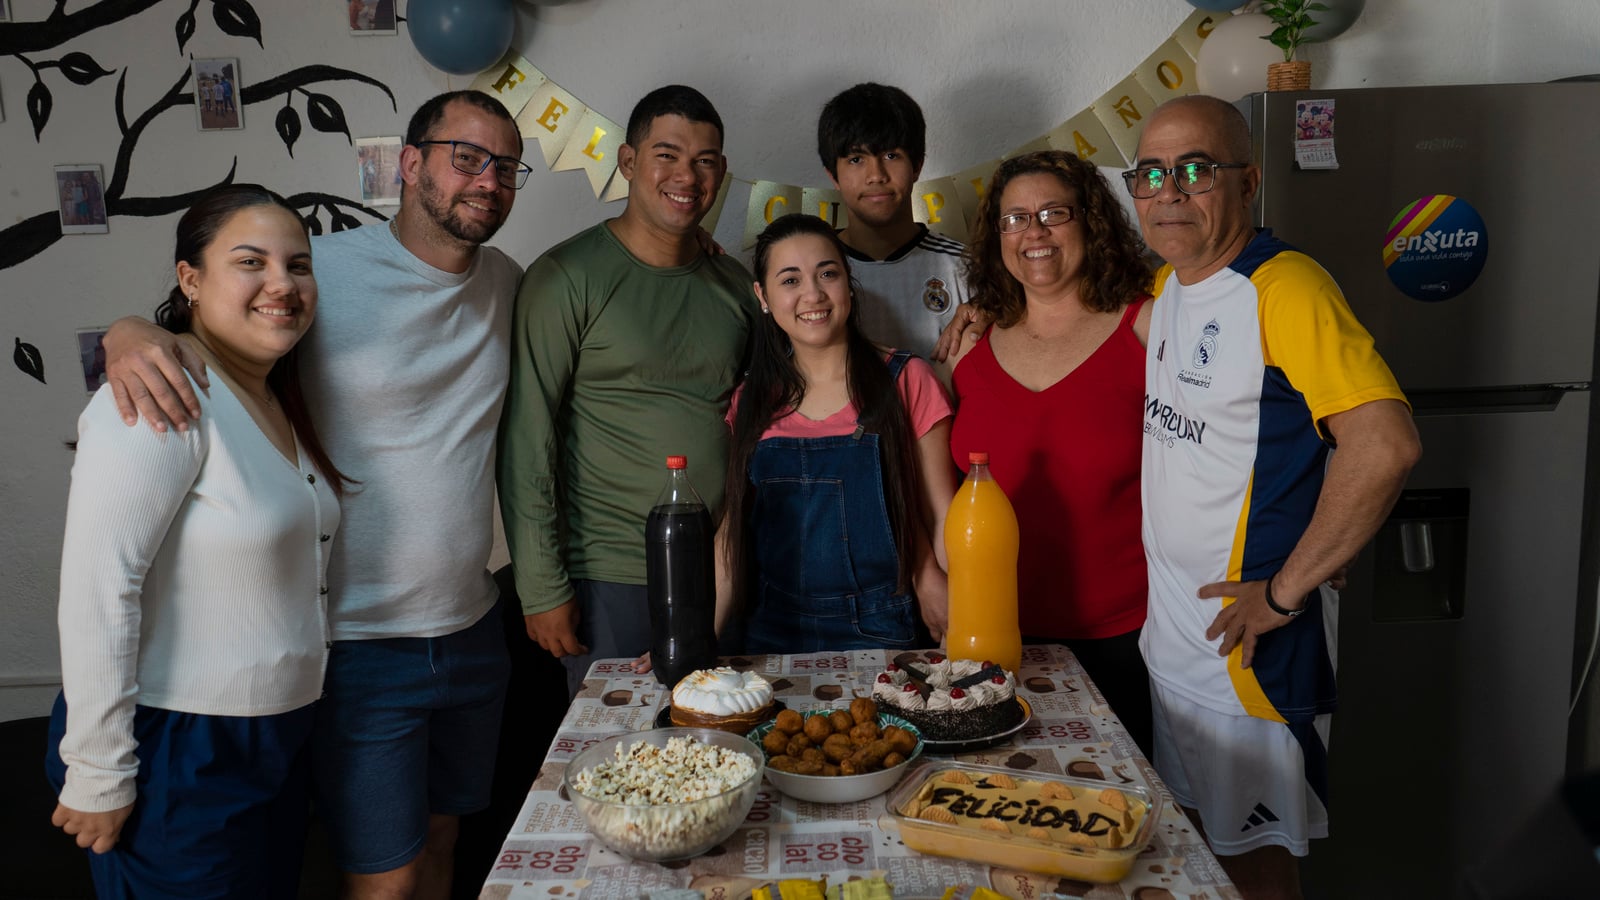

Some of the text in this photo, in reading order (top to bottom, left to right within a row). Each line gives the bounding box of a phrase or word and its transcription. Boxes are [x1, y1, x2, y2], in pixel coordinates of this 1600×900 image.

[594, 663, 618, 674] lat
[815, 658, 831, 669] co
[1048, 725, 1068, 738] co
[1066, 721, 1091, 740] cho
[554, 738, 582, 753] lat
[553, 846, 586, 873] cho
[744, 829, 766, 873] cacao
[785, 844, 814, 865] lat
[817, 843, 839, 861] co
[841, 837, 869, 864] cho
[496, 850, 532, 870] lat
[530, 851, 555, 869] co
